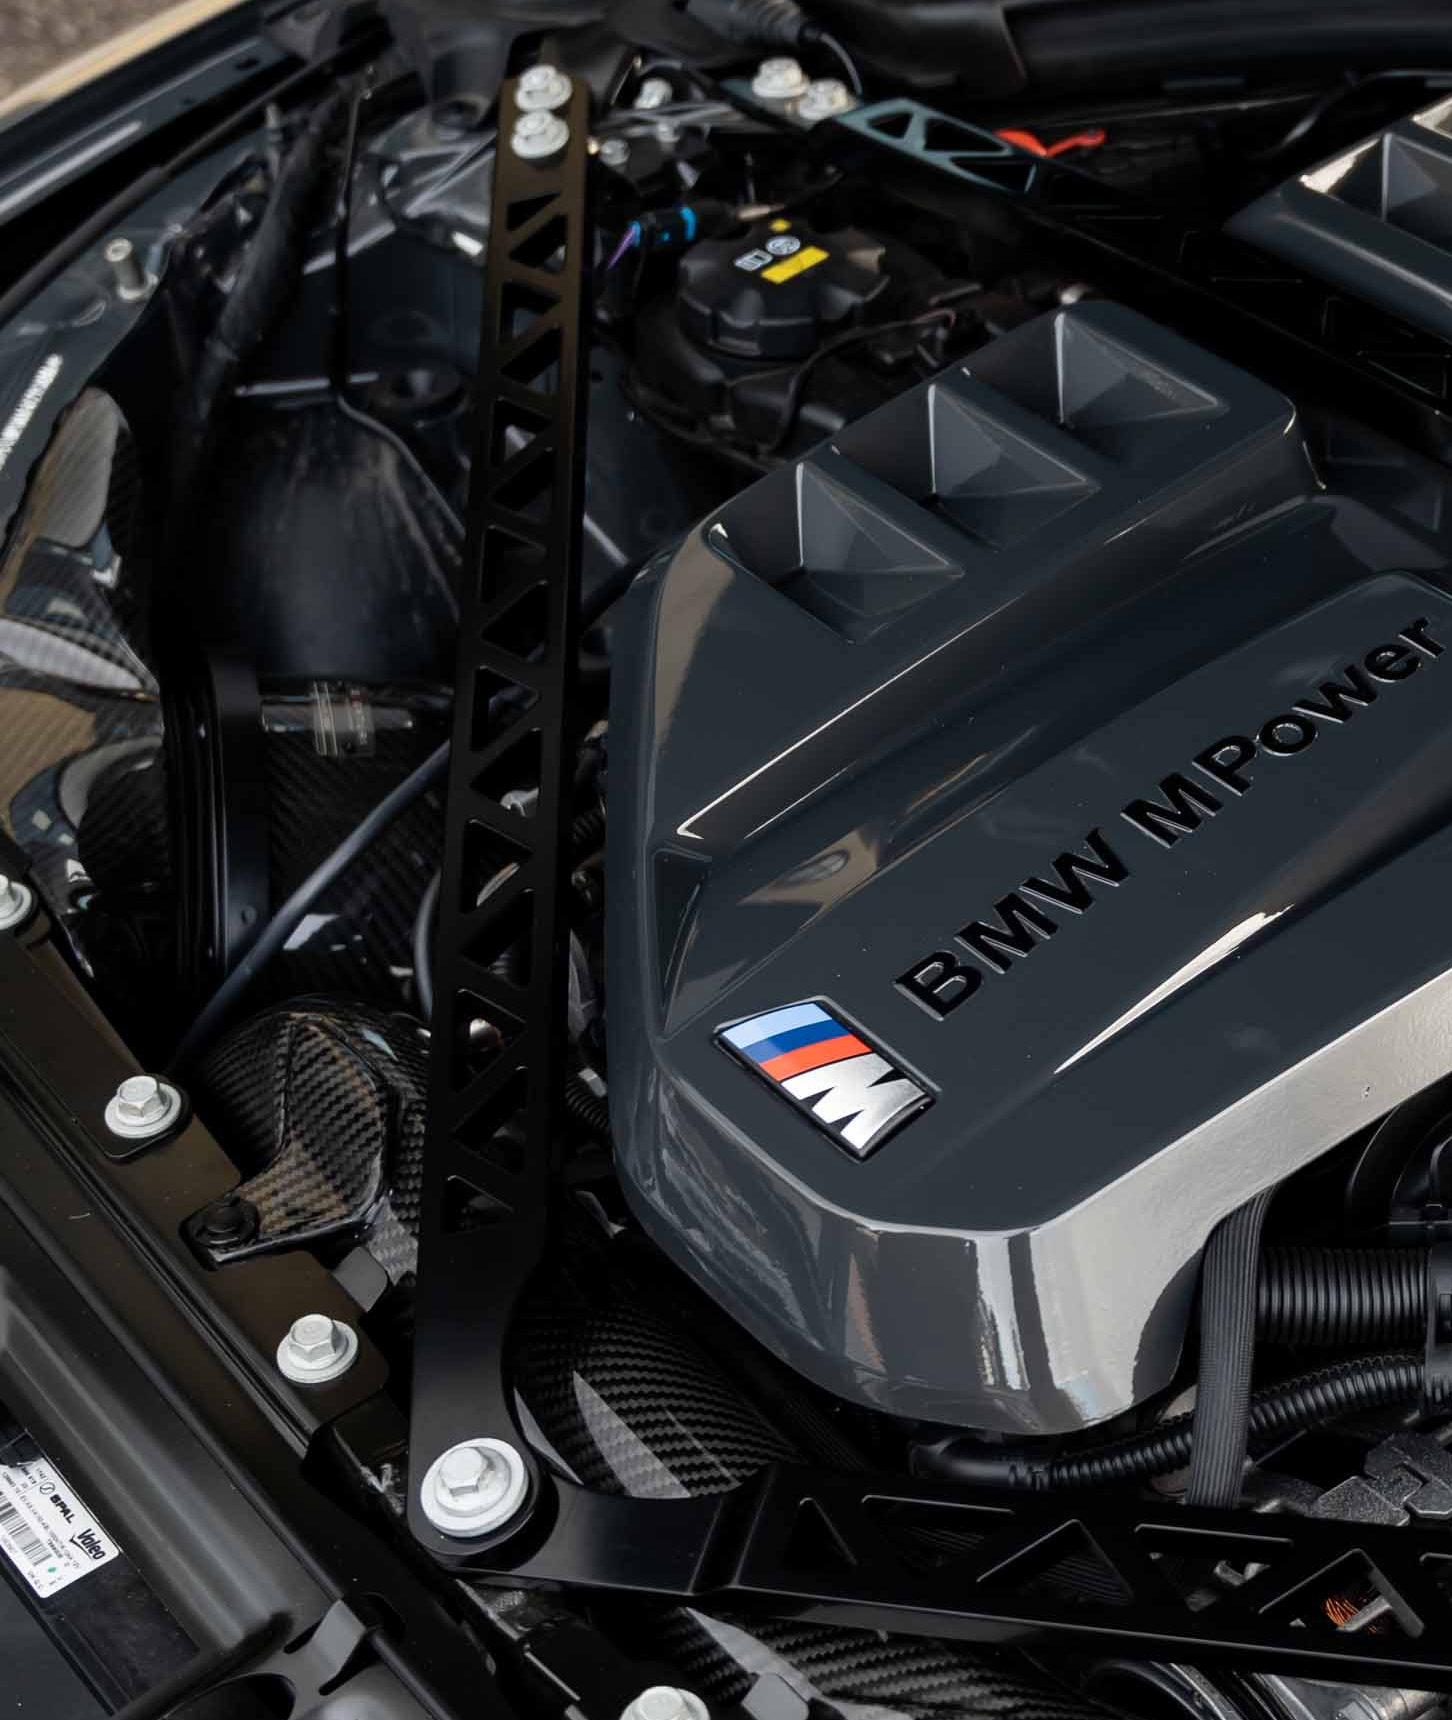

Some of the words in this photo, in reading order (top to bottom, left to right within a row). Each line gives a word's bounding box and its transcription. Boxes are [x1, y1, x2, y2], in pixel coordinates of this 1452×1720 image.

[894, 827, 1131, 1021] BMW
[1120, 616, 1448, 849] MPower
[77, 1528, 106, 1560] Valeo
